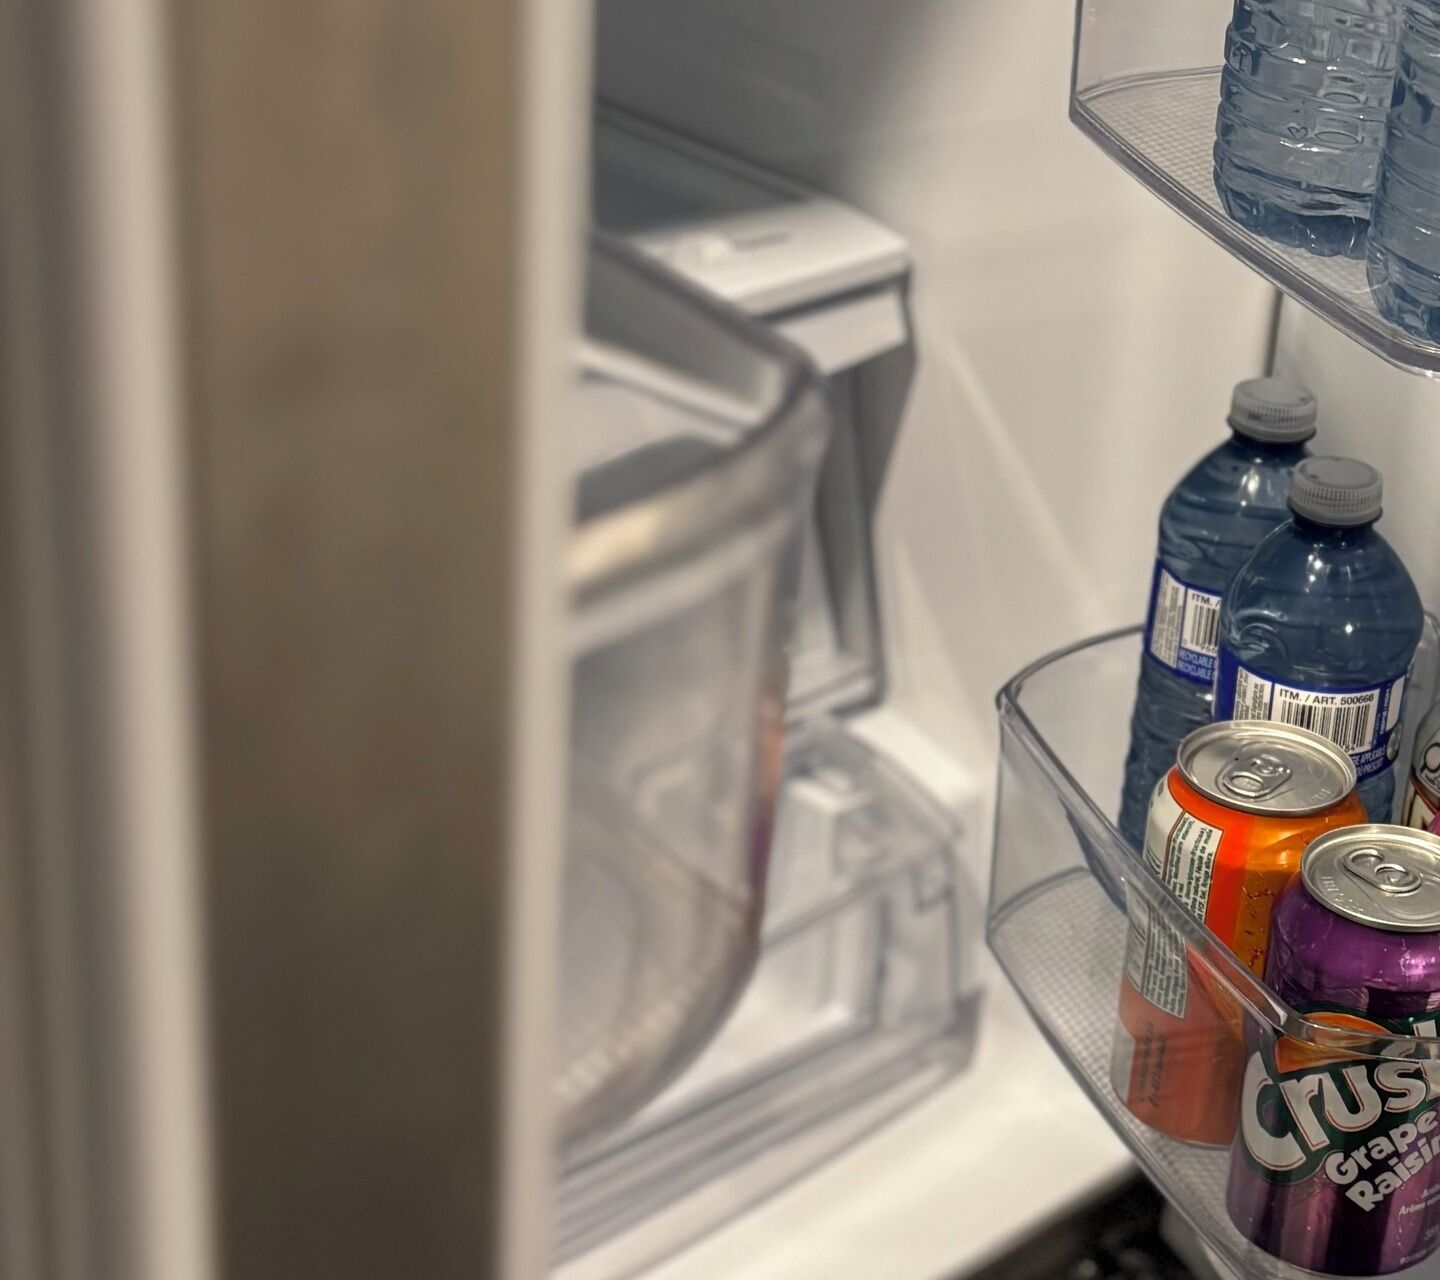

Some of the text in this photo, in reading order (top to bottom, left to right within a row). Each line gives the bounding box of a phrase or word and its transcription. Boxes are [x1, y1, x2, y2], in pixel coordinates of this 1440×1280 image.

[1192, 592, 1212, 606] ITM.
[1279, 688, 1302, 702] ITM.
[1312, 695, 1338, 706] ART.
[1340, 693, 1375, 706] 500666
[1324, 1110, 1439, 1185] Grape
